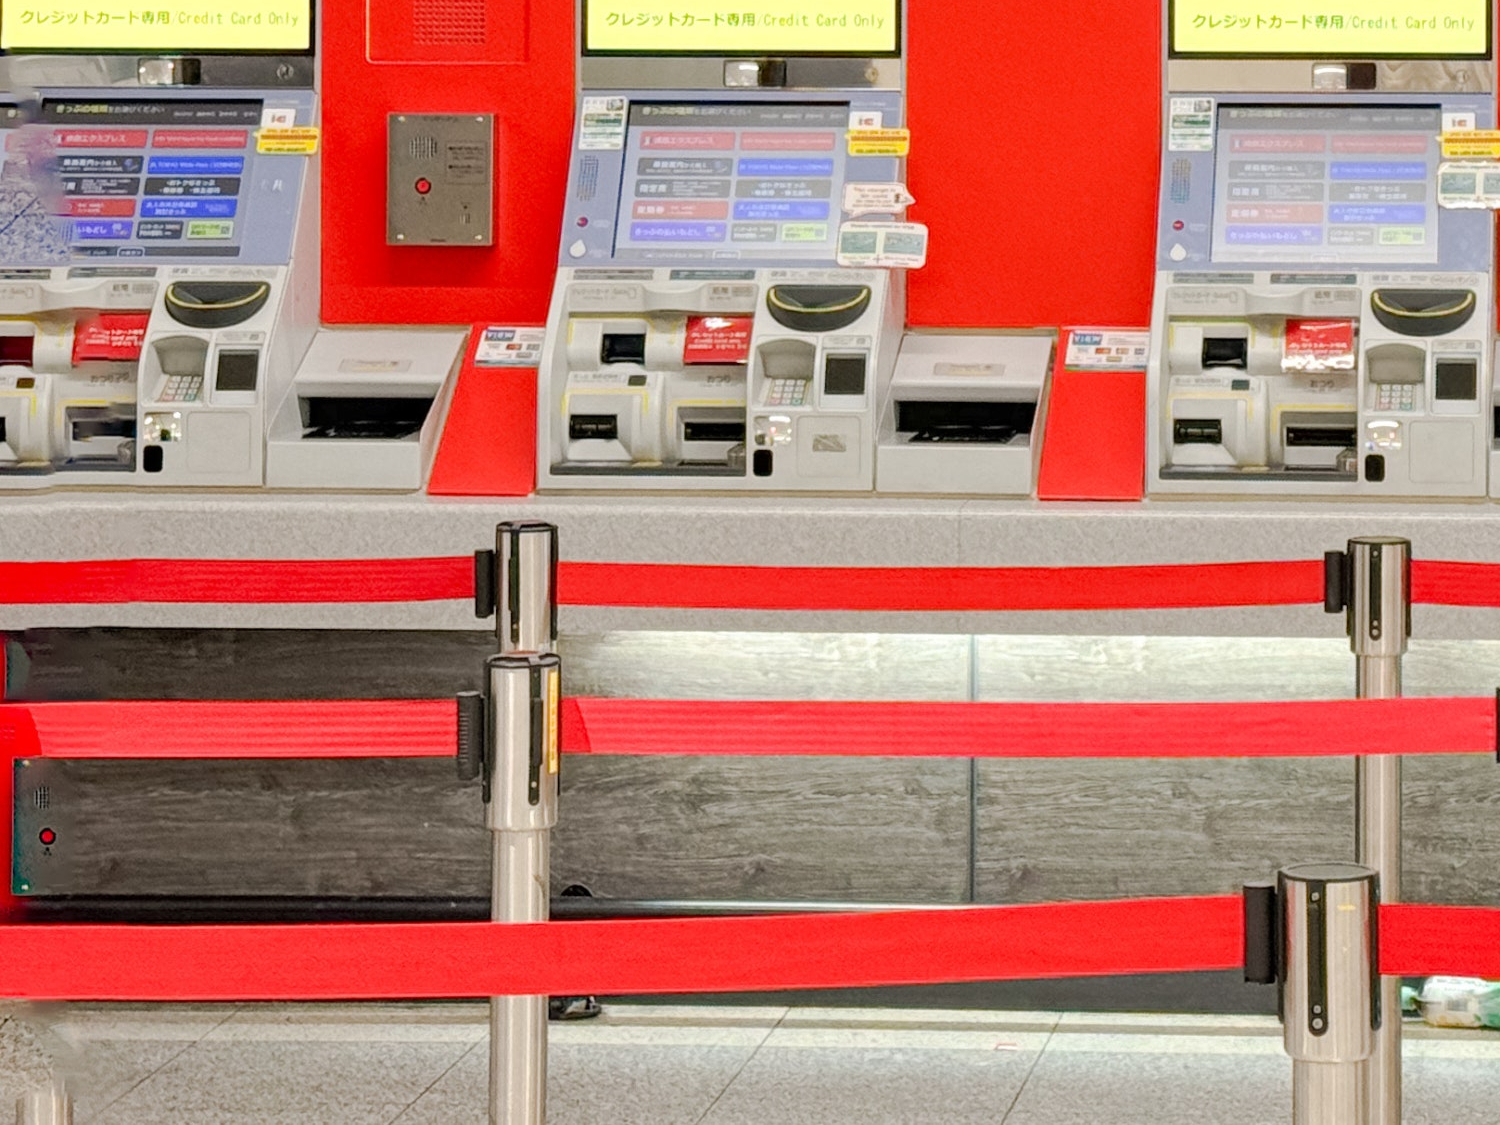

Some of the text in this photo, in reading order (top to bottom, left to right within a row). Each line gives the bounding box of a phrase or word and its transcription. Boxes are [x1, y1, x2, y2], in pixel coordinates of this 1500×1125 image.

[231, 9, 262, 25] Card
[268, 9, 300, 26] Only
[816, 13, 847, 27] Card
[854, 13, 885, 29] Only
[1405, 16, 1437, 30] Card
[1443, 16, 1475, 31] Only
